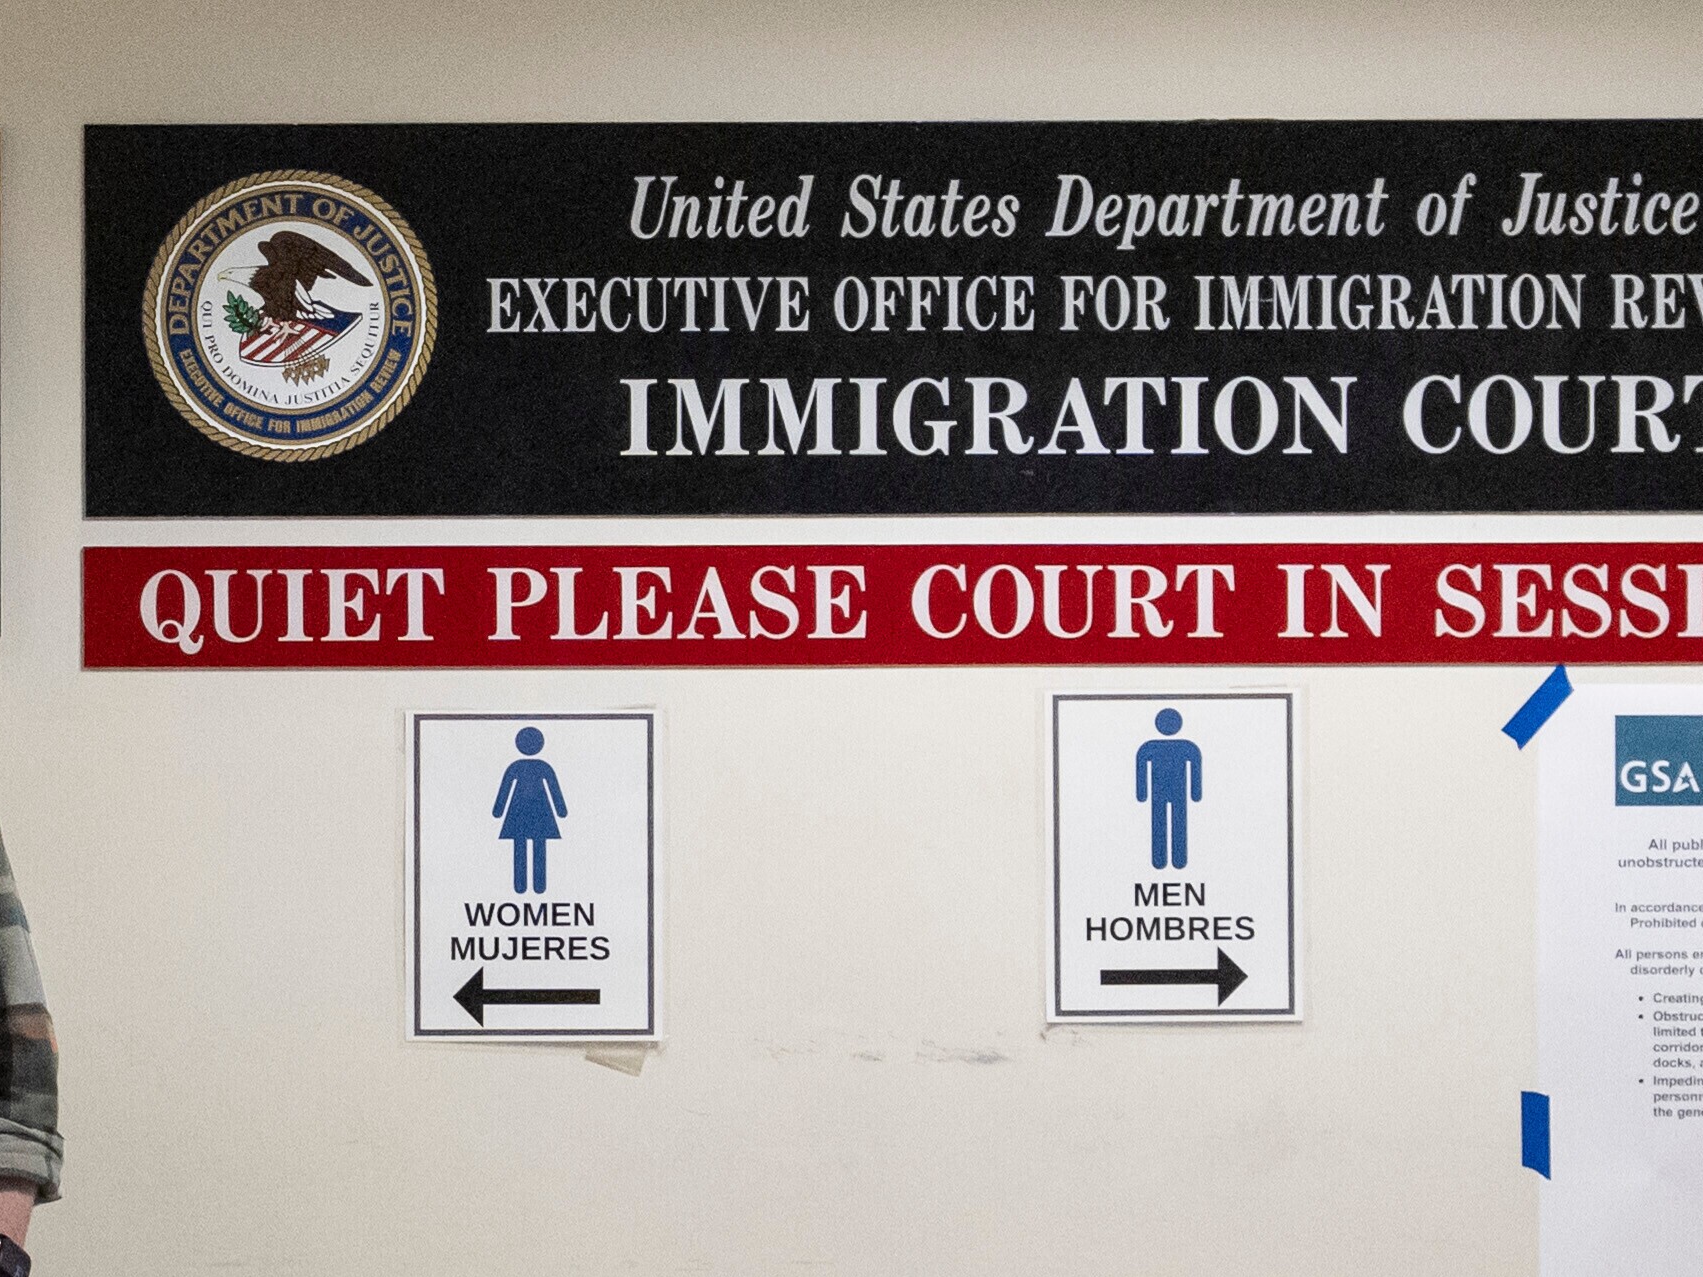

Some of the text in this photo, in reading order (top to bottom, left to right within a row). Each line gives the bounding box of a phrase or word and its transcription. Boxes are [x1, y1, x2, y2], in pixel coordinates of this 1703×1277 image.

[630, 172, 1700, 251] United States Department of Justice
[169, 193, 416, 338] DEPARTMENT OF JUSTICE
[486, 276, 810, 333] EXECUTIVE
[833, 275, 1035, 333] OFFICE
[1059, 274, 1171, 332] FOR
[1193, 272, 1587, 331] IMMIGRATION
[204, 335, 225, 367] PRO
[223, 365, 280, 405] DOMINA
[284, 376, 351, 406] JUSTITIA
[352, 301, 381, 377] SEQUITUR
[267, 419, 291, 433] FOR
[619, 375, 1358, 457] IMMIGRATION
[139, 567, 445, 655] QUIET
[487, 565, 868, 641] PLEASE
[911, 563, 1236, 639] COURT
[1277, 563, 1391, 638] IN
[1619, 759, 1701, 793] GSA
[1647, 838, 1667, 850] All
[1134, 882, 1205, 906] MEN
[464, 902, 595, 927] WOMEN
[1614, 902, 1626, 913] In
[1086, 916, 1255, 941] HOMBRES
[1630, 917, 1697, 928] Prohibited
[451, 936, 610, 961] MUJERES
[1615, 948, 1632, 959] All
[1636, 951, 1689, 962] persons
[1630, 964, 1695, 978] disorderly
[1652, 1026, 1696, 1037] limited
[1652, 1057, 1696, 1069] docks,
[1652, 1106, 1673, 1117] the
